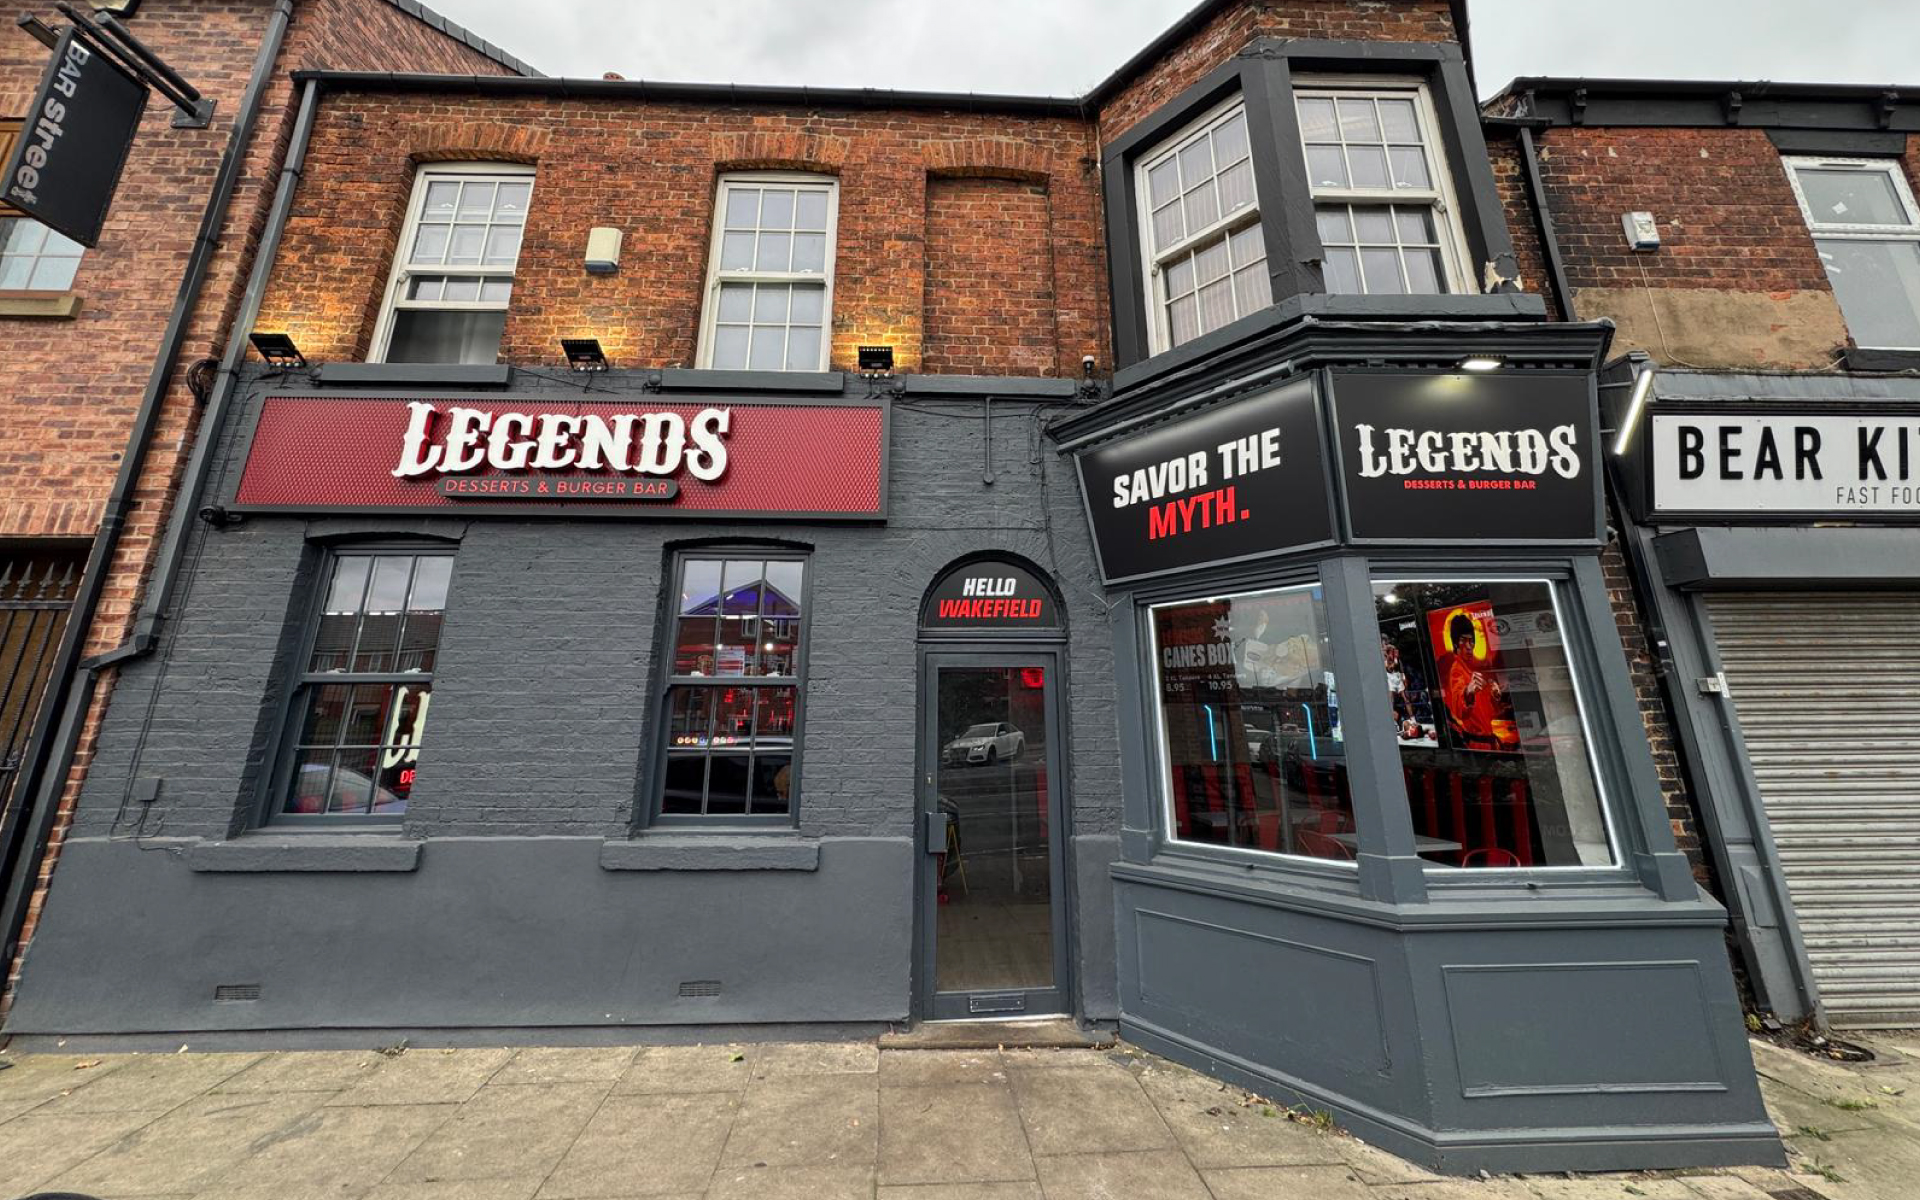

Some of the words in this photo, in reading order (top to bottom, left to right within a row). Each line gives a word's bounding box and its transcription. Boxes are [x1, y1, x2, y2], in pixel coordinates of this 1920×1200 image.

[53, 39, 90, 98] BAR
[392, 401, 731, 481] LEGENDS
[1356, 423, 1581, 479] LEGENDS
[1678, 426, 1823, 481] BEAR
[1858, 426, 1920, 481] KI
[1113, 451, 1208, 508] SAVOR
[1217, 427, 1281, 480] THE
[445, 479, 529, 493] DESSERTS
[537, 479, 549, 493] &
[556, 480, 626, 494] BURGER
[633, 481, 668, 495] BAR
[1404, 479, 1455, 490] DESSERTS
[1457, 479, 1466, 490] &
[1469, 480, 1511, 490] BURGER
[1514, 480, 1537, 490] BAR
[1836, 486, 1879, 504] FAST
[1149, 486, 1250, 540] MYTH.
[962, 578, 1017, 596] HELLO
[939, 599, 1042, 618] WAKEFIELD
[1163, 644, 1206, 668] CANES
[1208, 681, 1233, 691] 10.95
